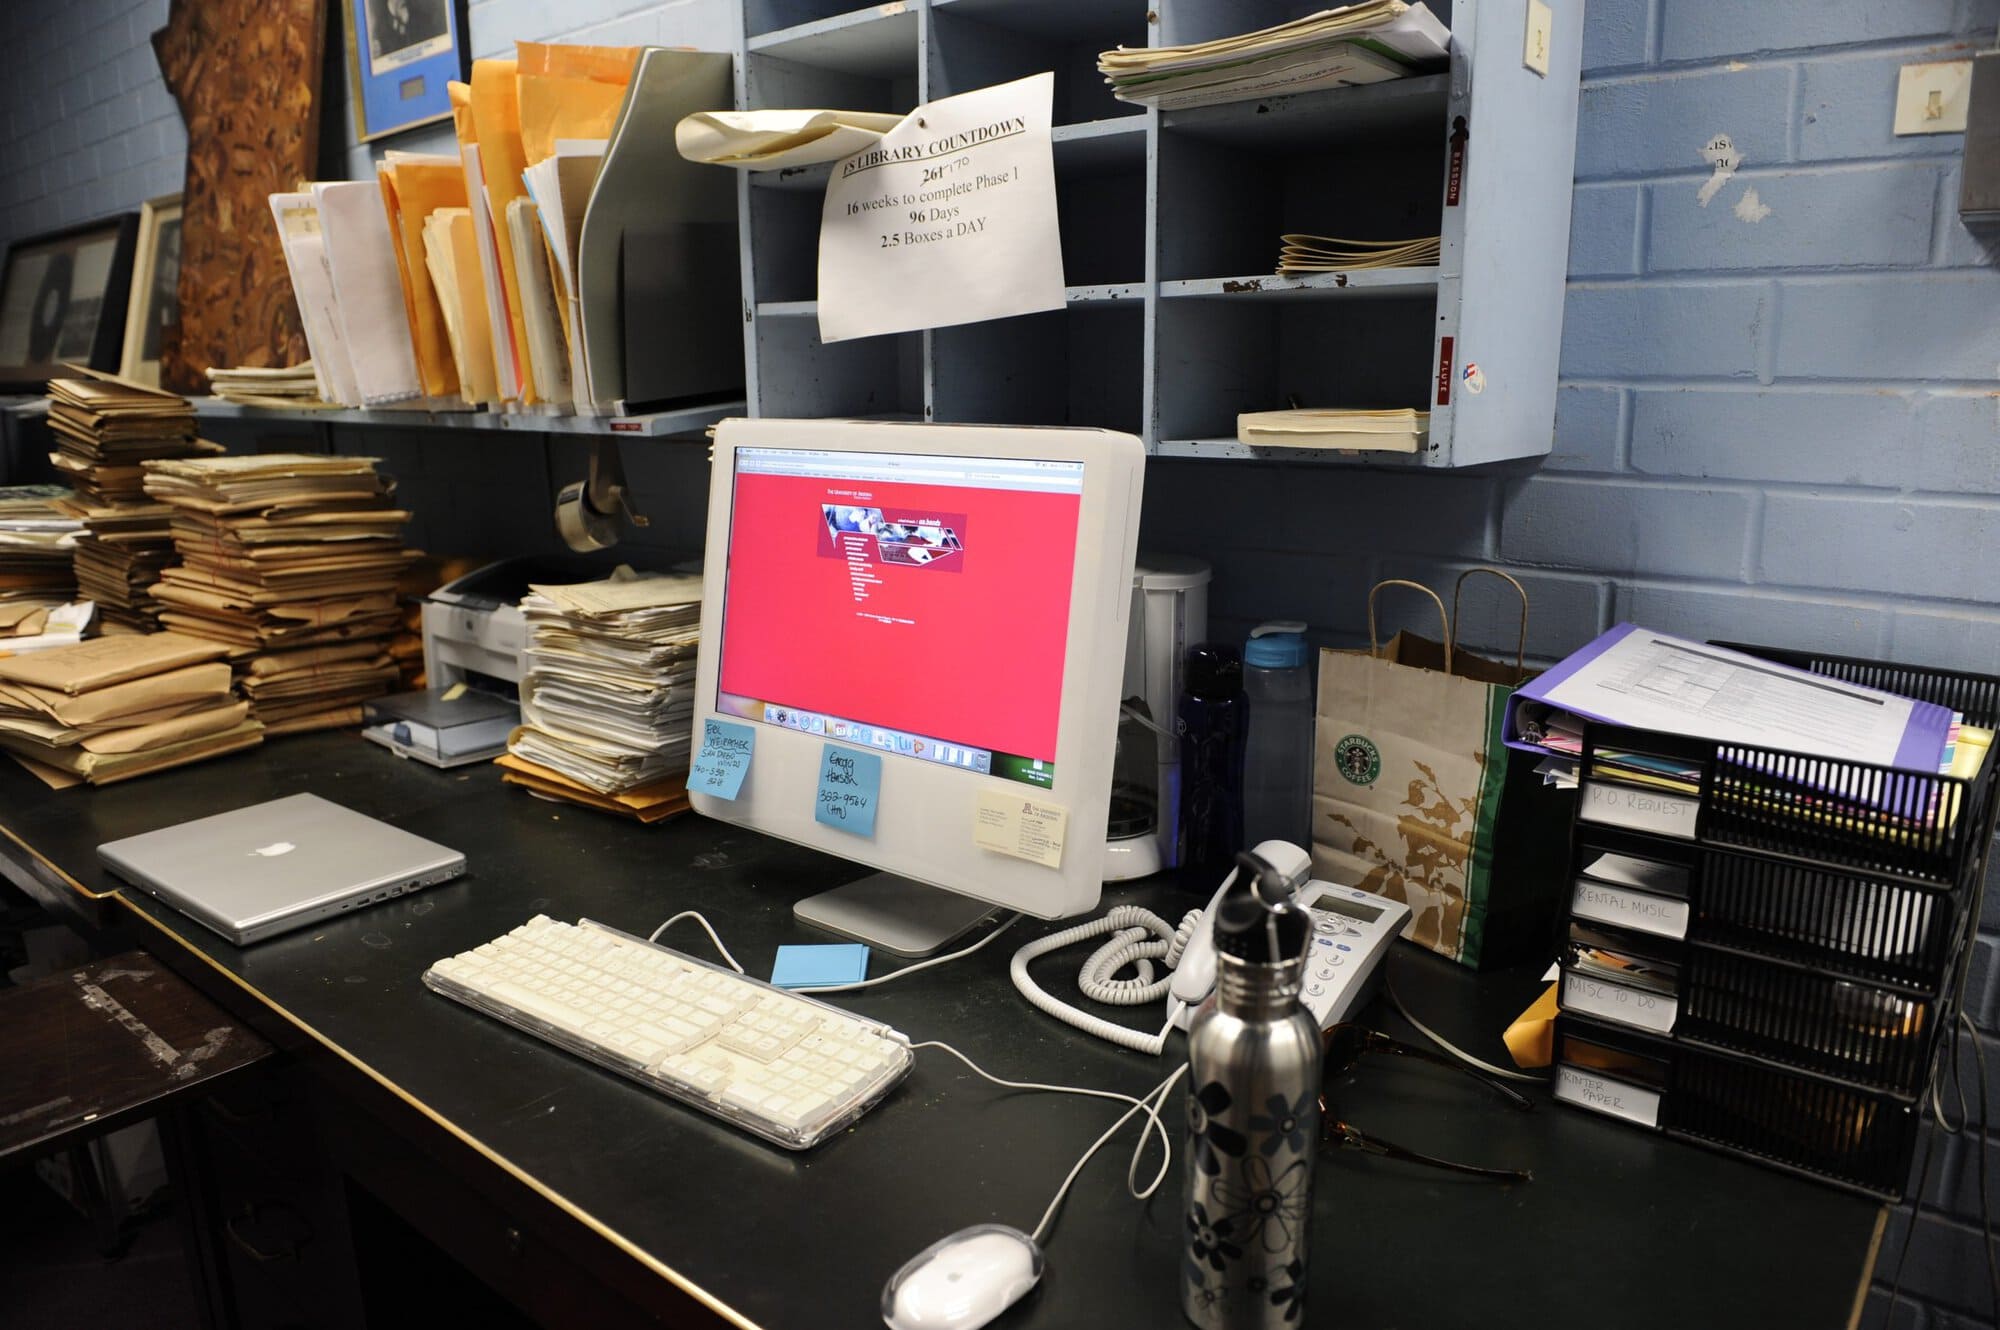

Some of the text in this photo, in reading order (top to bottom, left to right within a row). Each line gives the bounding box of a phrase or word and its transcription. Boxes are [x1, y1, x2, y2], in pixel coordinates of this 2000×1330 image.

[858, 144, 925, 169] LIBRARY
[928, 116, 1026, 156] COUNTDOWN
[847, 166, 1019, 216] 16 weeks to complete Phase 1
[1450, 151, 1461, 200] BASSOON
[909, 205, 960, 224] 96 Days
[880, 216, 987, 249] 2.5 Boxes a DAY
[1440, 360, 1449, 392] FLUTE
[1337, 737, 1378, 762] STARBUCKS
[1342, 767, 1372, 783] COFFEE
[1628, 792, 1692, 816] REQUEST
[1575, 886, 1673, 919] RENTAL MUSIC
[1569, 977, 1656, 1009] MISC TO DO
[1559, 1070, 1606, 1092] PRINTER
[1583, 1089, 1624, 1110] PAPER
